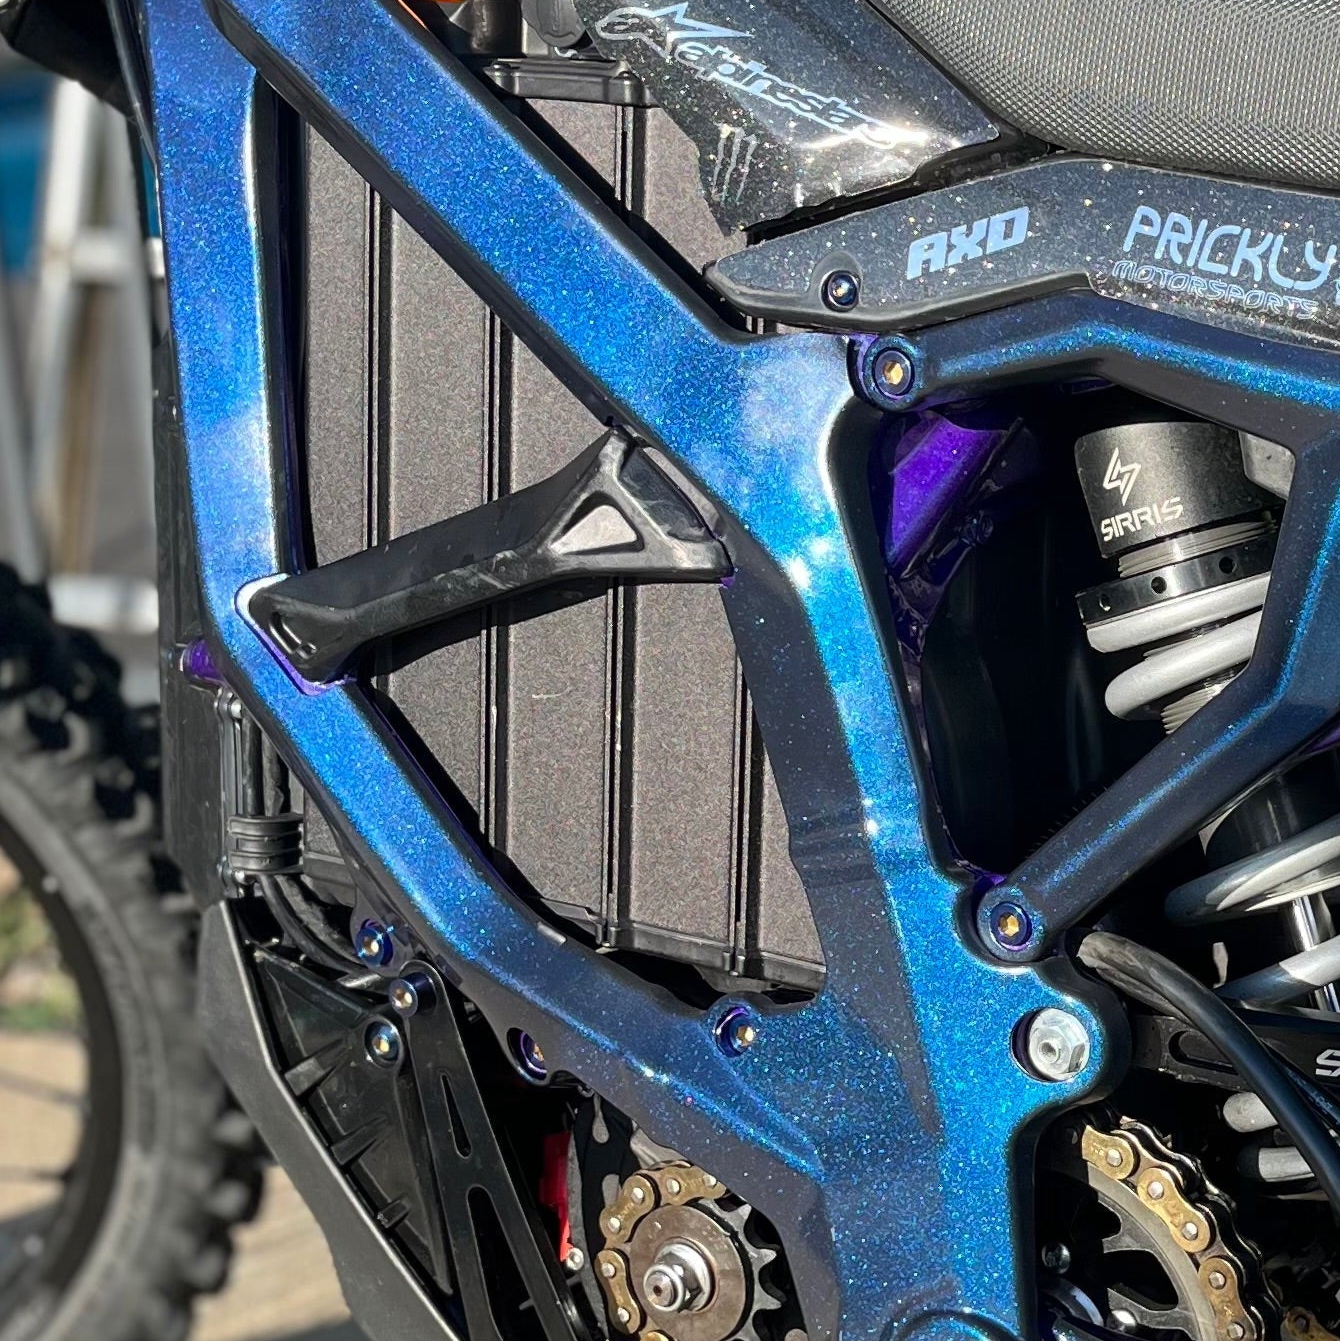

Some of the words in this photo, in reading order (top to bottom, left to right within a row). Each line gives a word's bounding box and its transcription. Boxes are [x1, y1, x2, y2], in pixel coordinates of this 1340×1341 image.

[1122, 205, 1338, 291] PRICKLY
[1110, 259, 1320, 321] MOTORSPORTS
[1100, 496, 1185, 542] SIRRIS
